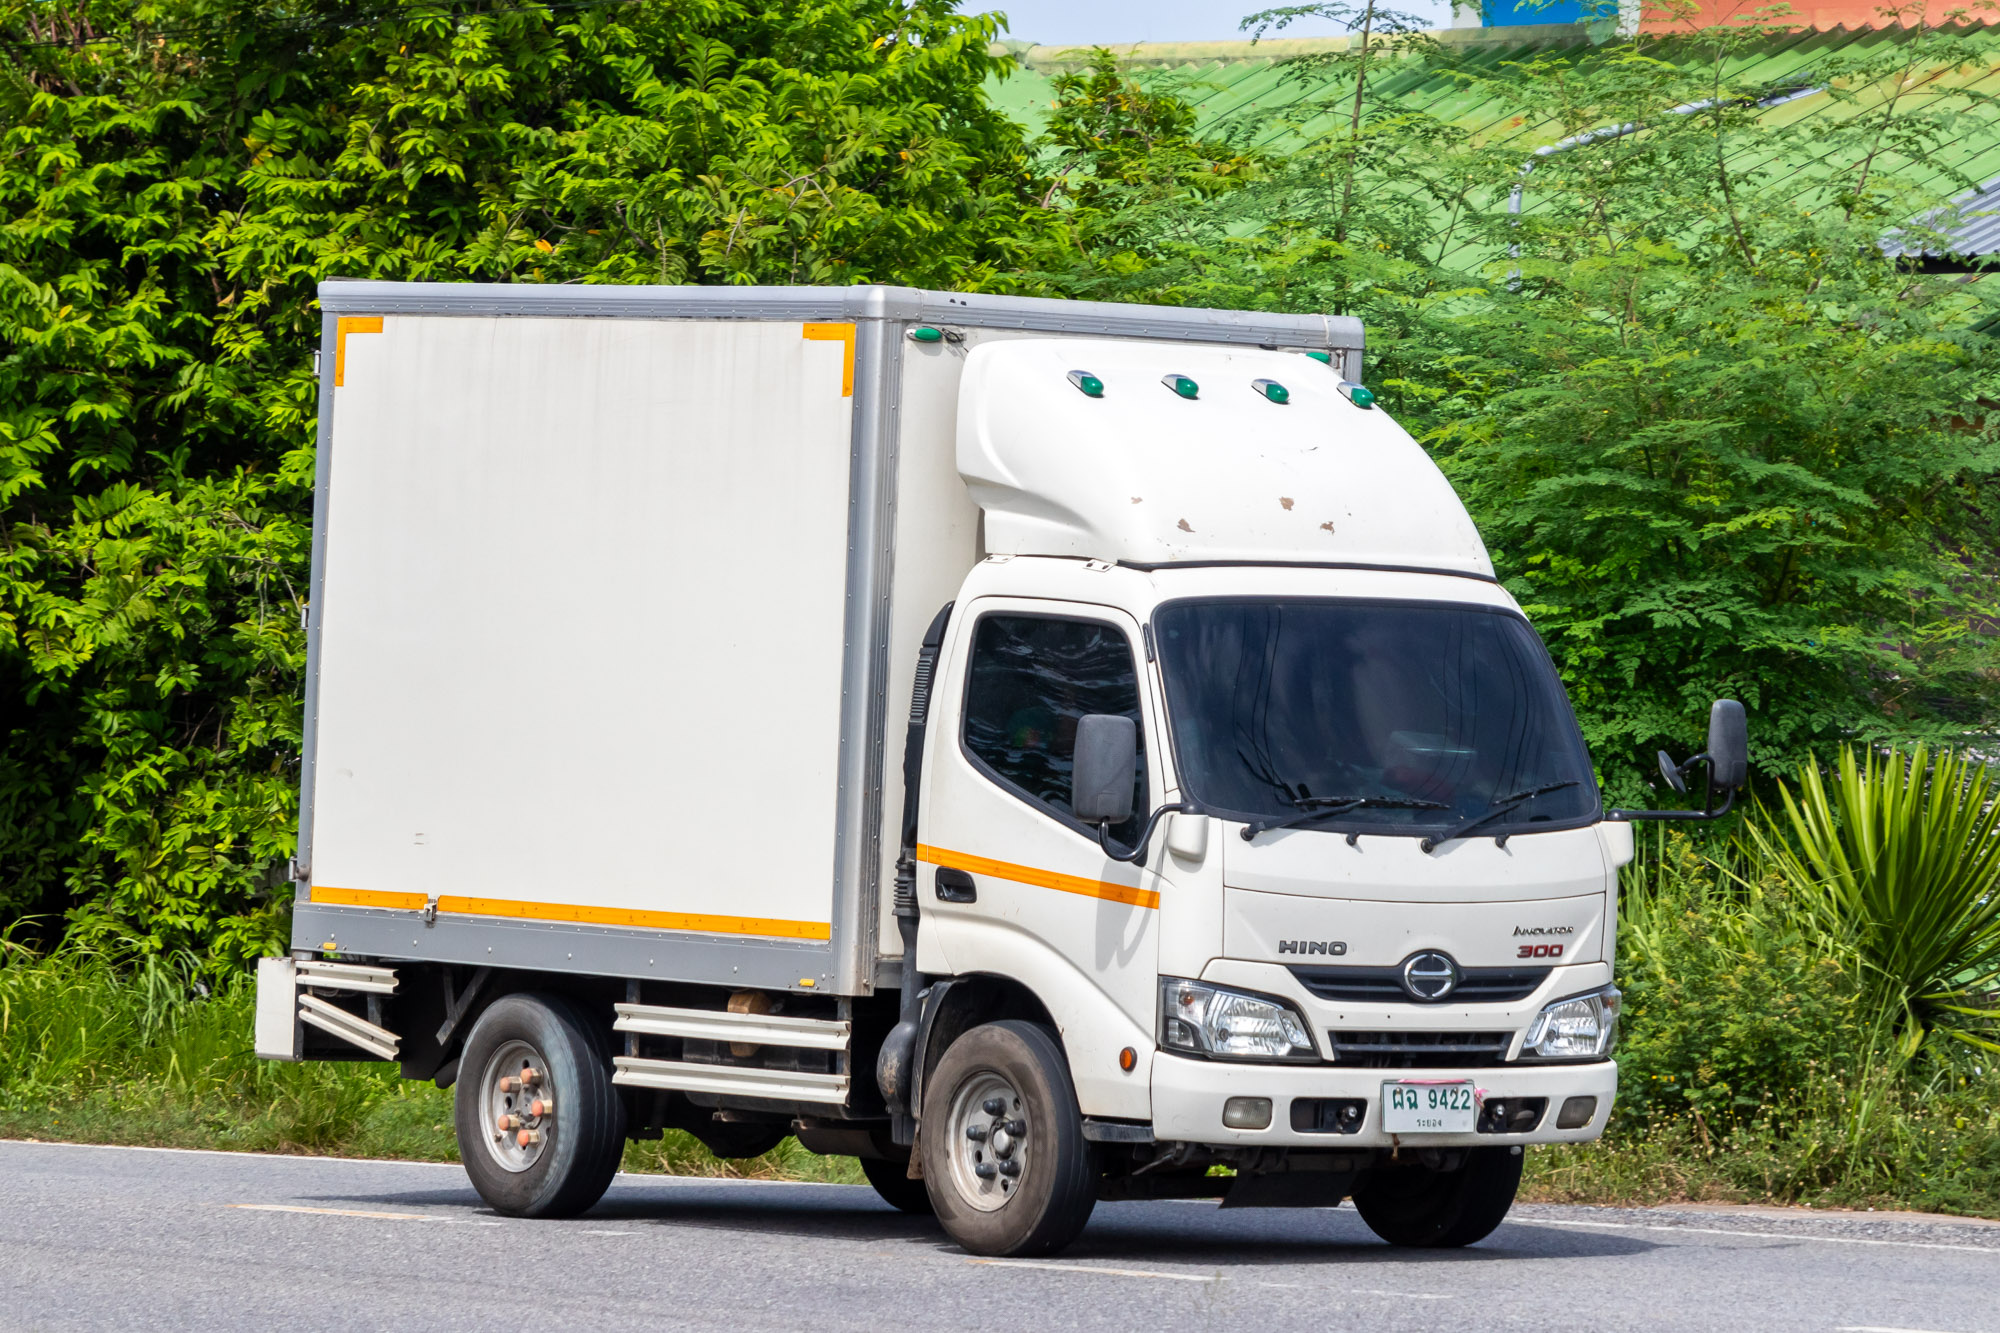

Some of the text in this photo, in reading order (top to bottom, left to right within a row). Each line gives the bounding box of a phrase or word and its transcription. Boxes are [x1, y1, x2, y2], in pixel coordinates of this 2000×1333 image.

[1279, 940, 1348, 956] HINO
[1516, 944, 1564, 958] 300
[1428, 1088, 1471, 1110] 9422
